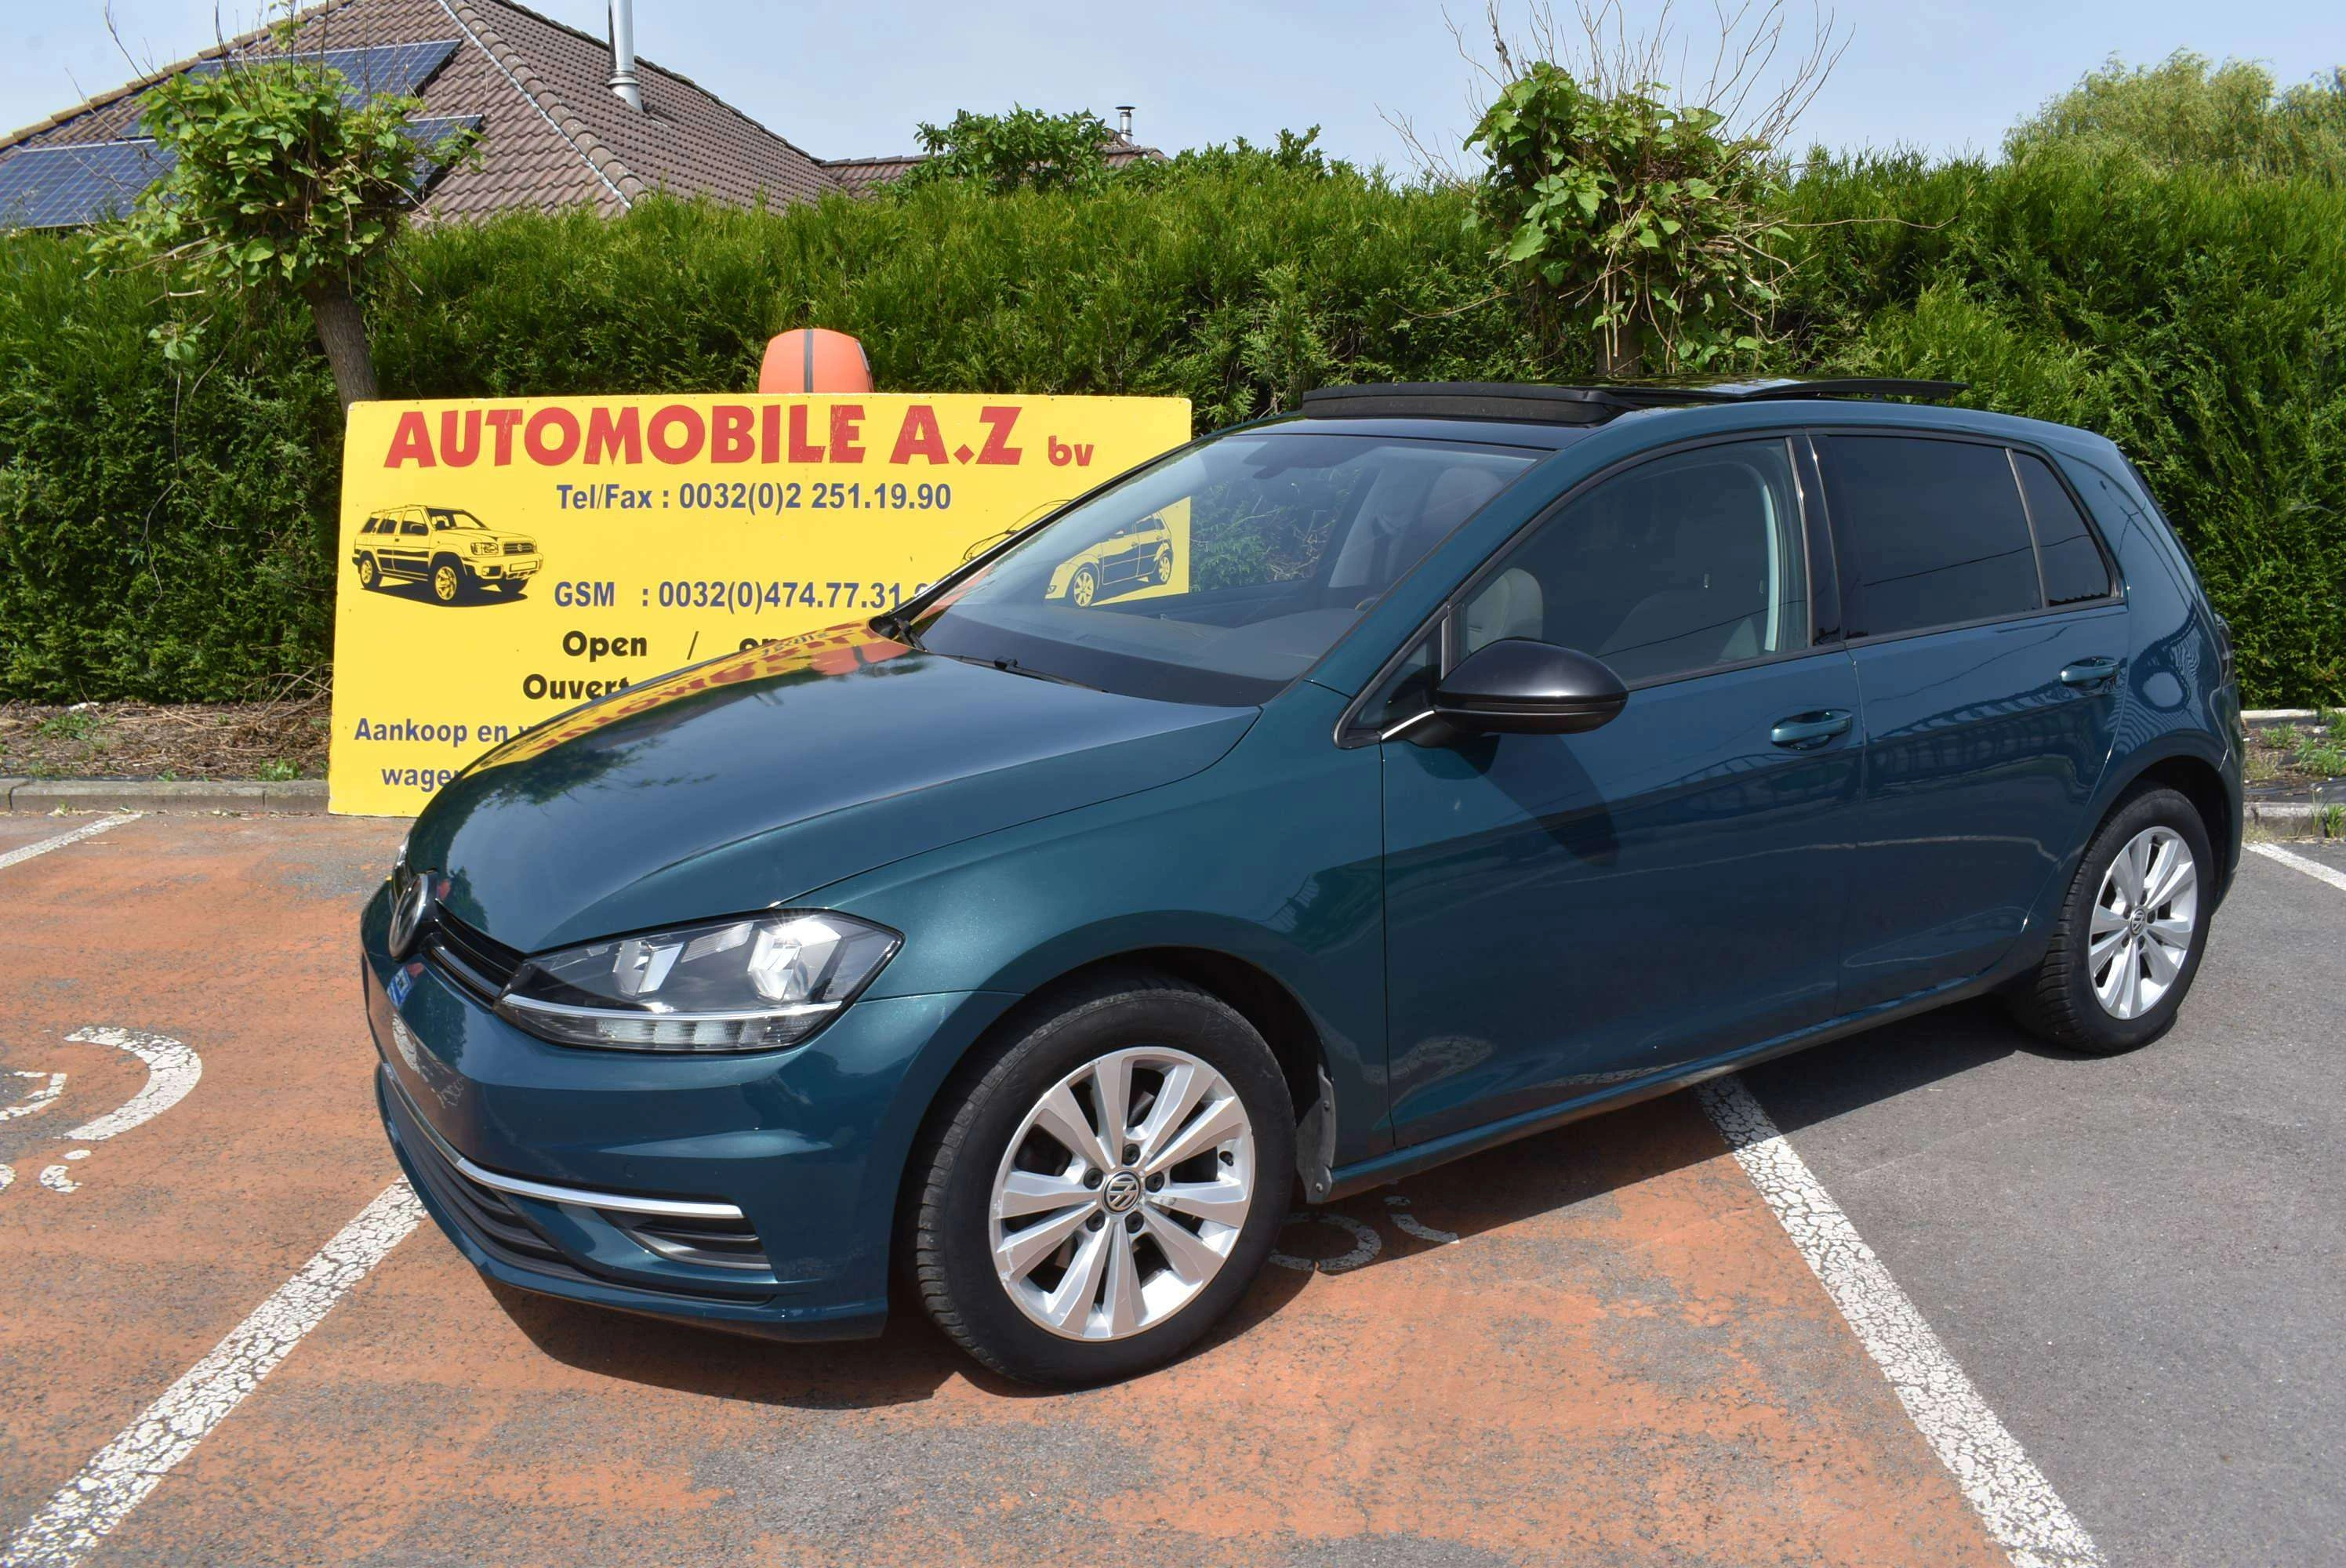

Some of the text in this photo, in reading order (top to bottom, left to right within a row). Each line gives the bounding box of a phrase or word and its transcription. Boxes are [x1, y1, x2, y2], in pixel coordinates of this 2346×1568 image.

[384, 404, 1094, 469] AUTOMOBILE A.Z bv
[556, 483, 652, 510] Tel/Fax
[679, 482, 801, 516] 0032(0)2
[812, 482, 951, 510] 251.19.90
[554, 581, 615, 608] GSM
[562, 630, 648, 662] Open
[354, 717, 467, 748] Aankoop
[478, 724, 508, 742] en
[381, 768, 459, 793] wage
